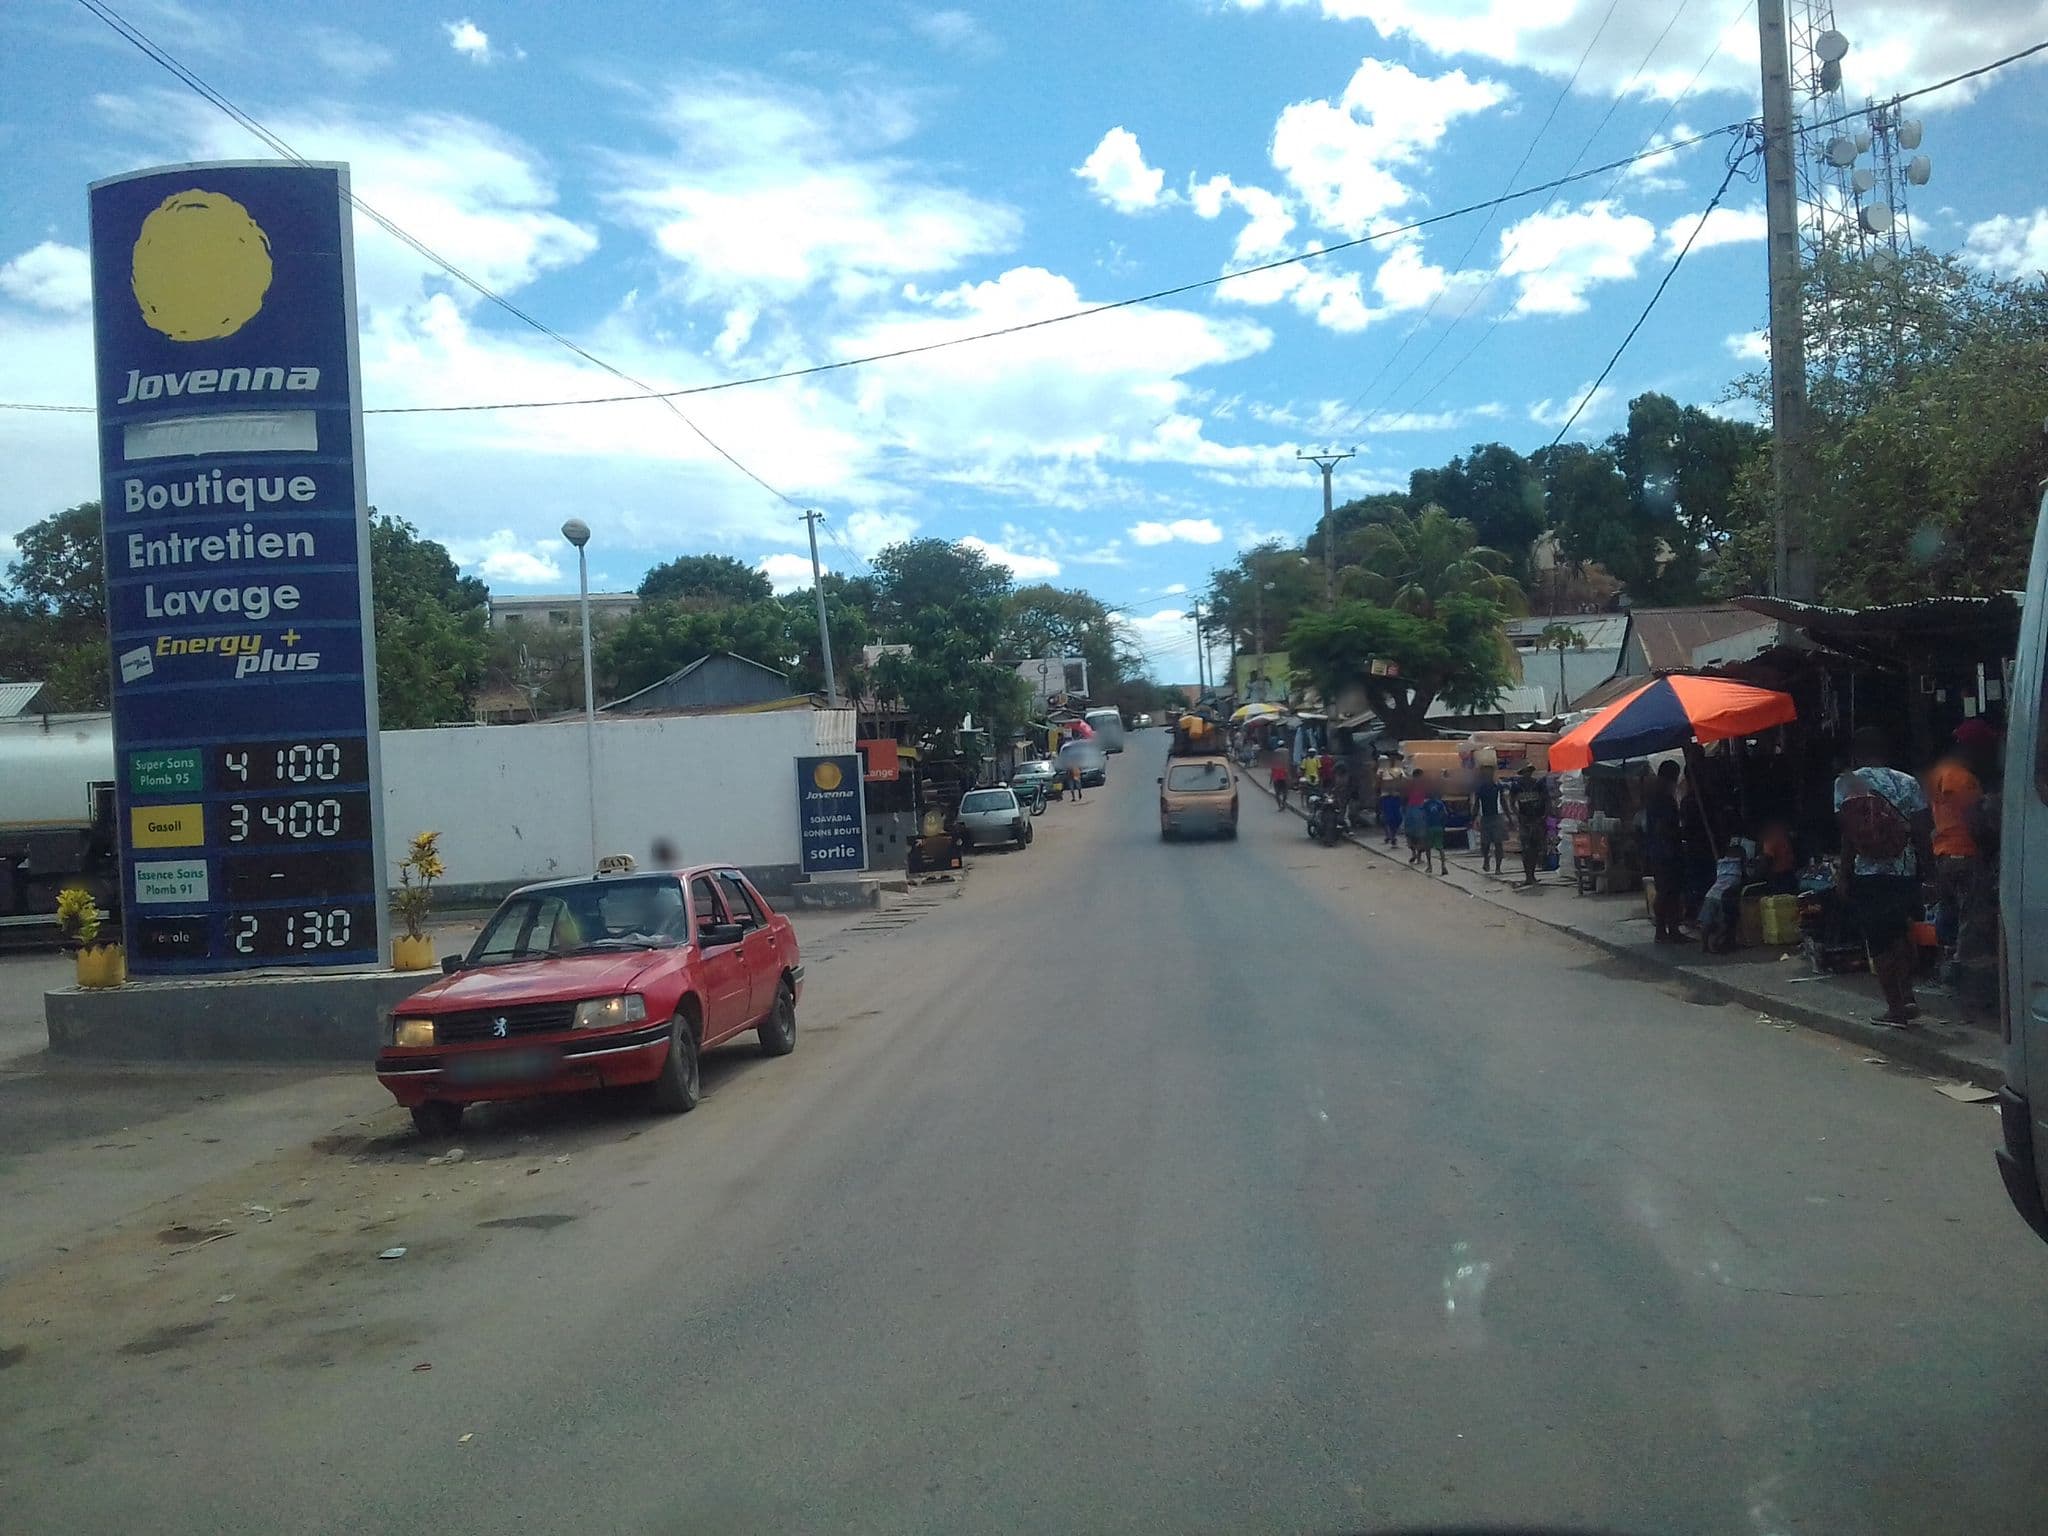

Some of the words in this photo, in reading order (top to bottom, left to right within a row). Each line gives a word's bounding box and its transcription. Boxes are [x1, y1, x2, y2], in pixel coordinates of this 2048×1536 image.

[118, 367, 320, 404] Jovenna
[125, 469, 316, 512] Boutique
[129, 523, 314, 568] Entretien
[146, 584, 300, 620] Lavage
[156, 634, 261, 657] Energy
[235, 649, 320, 678] plus
[135, 760, 164, 772] Super
[166, 757, 194, 769] Sans
[140, 773, 172, 785] Plomb
[176, 772, 190, 784] 95
[805, 791, 854, 800] Jovenna
[148, 820, 182, 833] Gasoil
[803, 829, 832, 837] BONNE
[834, 827, 861, 836] ROUTE
[810, 844, 856, 859] sortie
[137, 870, 174, 880] Essence
[177, 868, 204, 880] Sans
[146, 884, 177, 895] Plomb
[179, 883, 192, 894] 91
